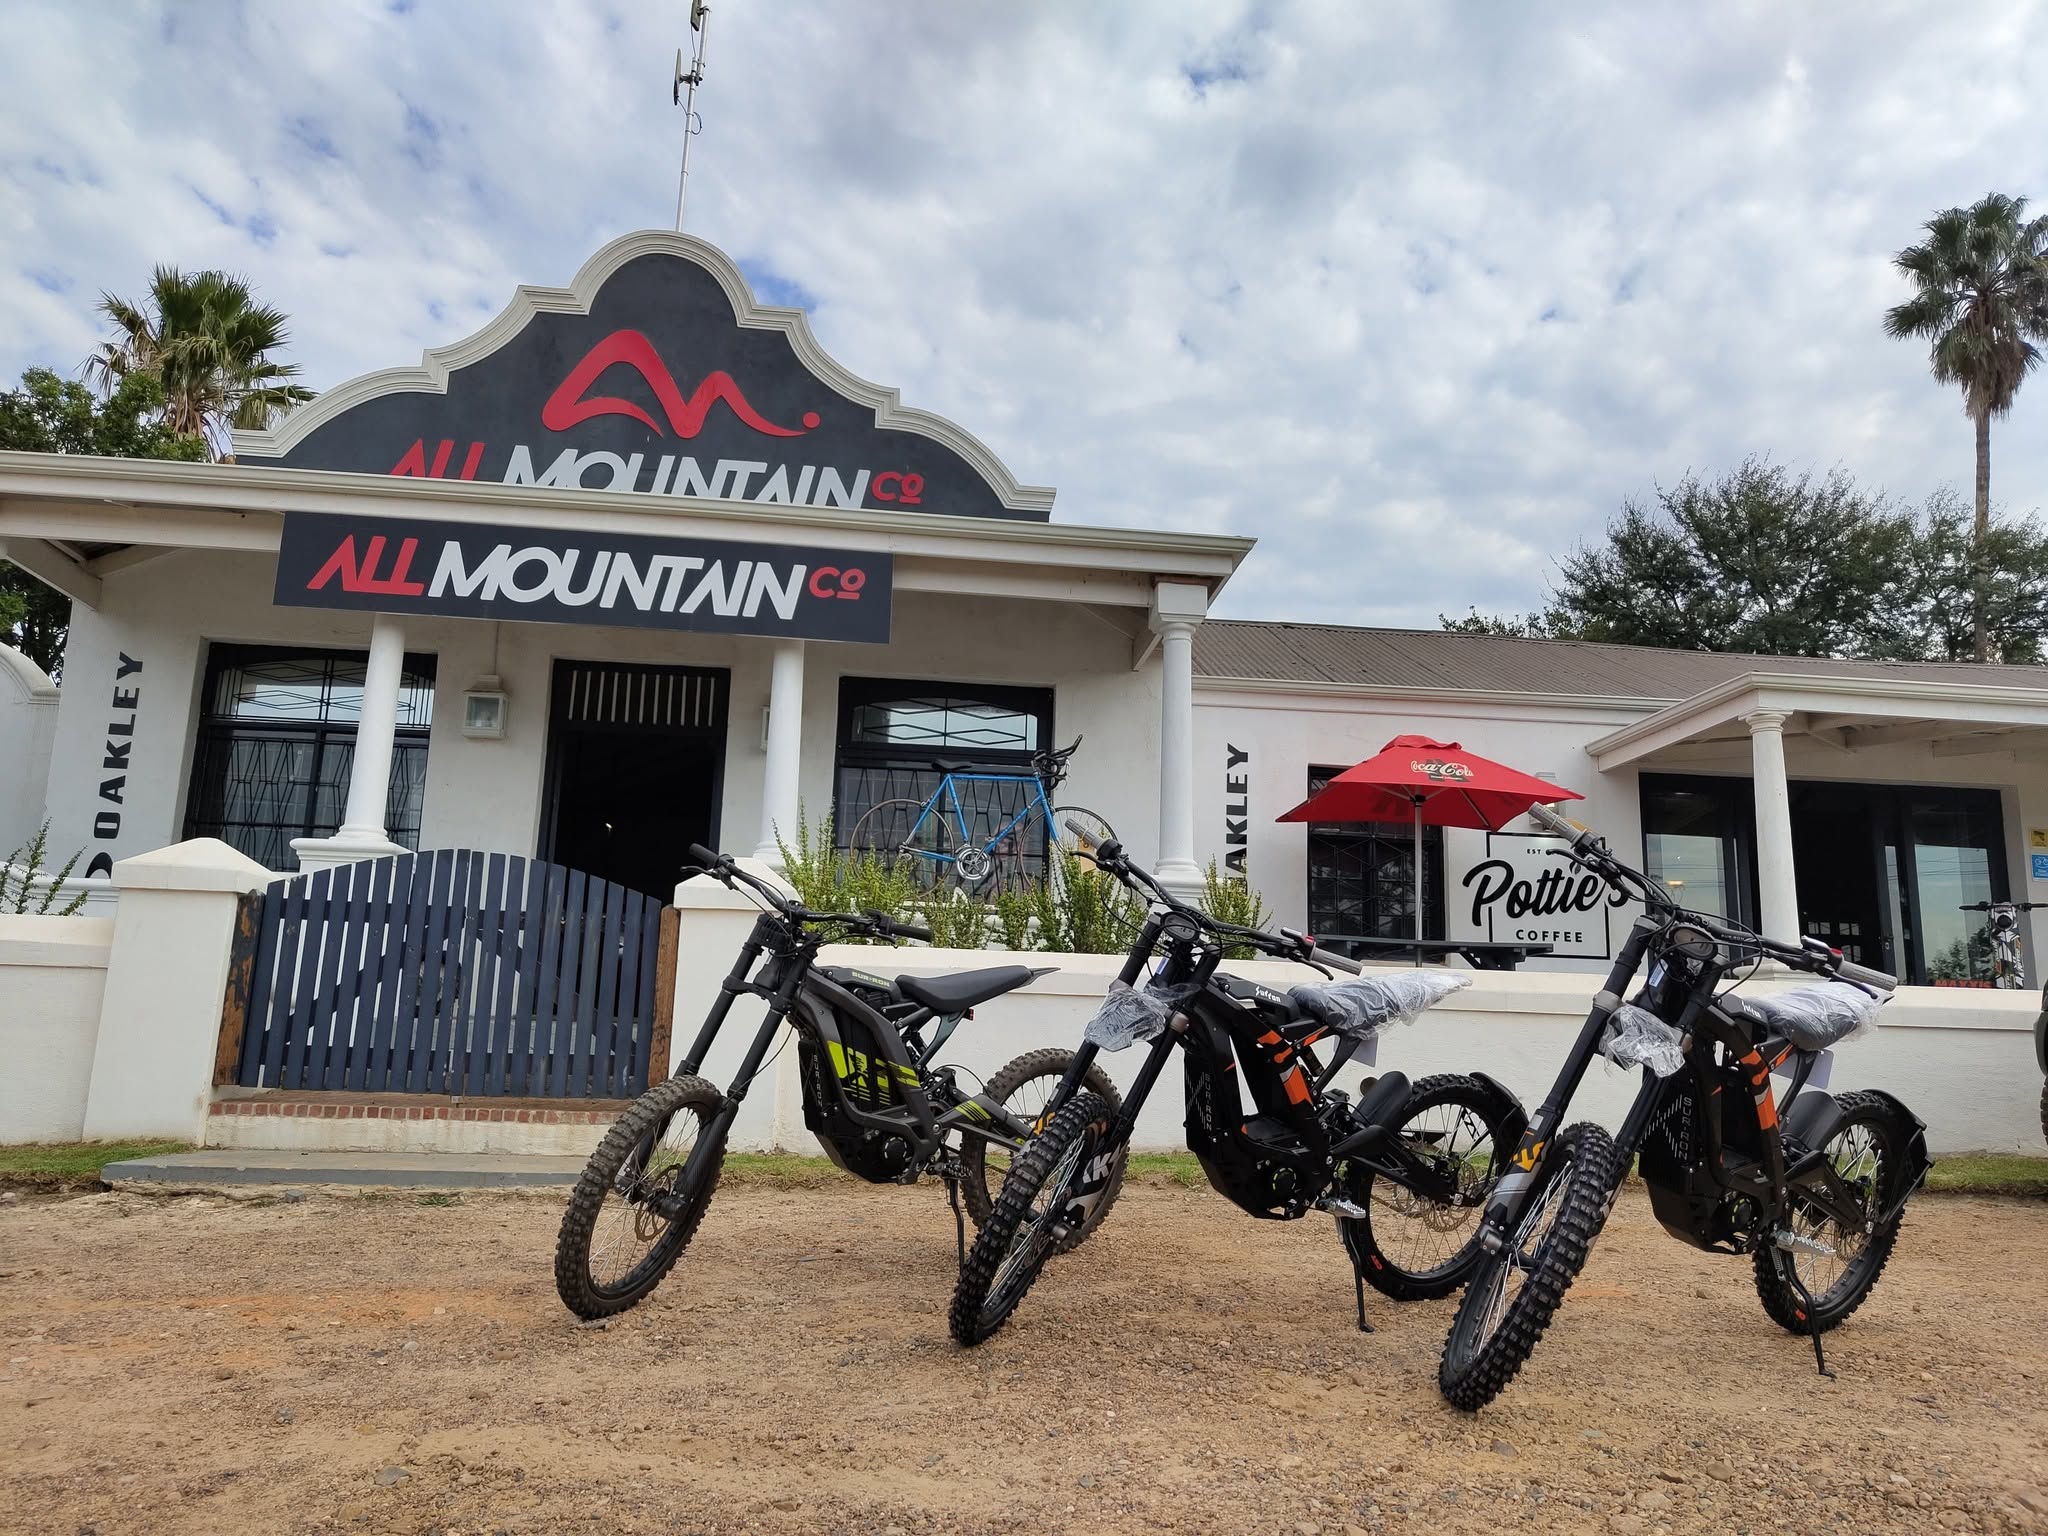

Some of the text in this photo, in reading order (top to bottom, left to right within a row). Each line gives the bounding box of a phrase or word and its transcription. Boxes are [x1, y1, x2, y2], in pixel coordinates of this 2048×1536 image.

[502, 444, 871, 510] MOUNTAIN
[306, 534, 425, 596] ALL
[428, 540, 807, 620] MOUNTAIN
[94, 651, 144, 840] OAKLEY
[1411, 761, 1474, 777] Coca-Cola
[1225, 743, 1249, 896] AKLEY
[1516, 930, 1583, 943] COFFEE
